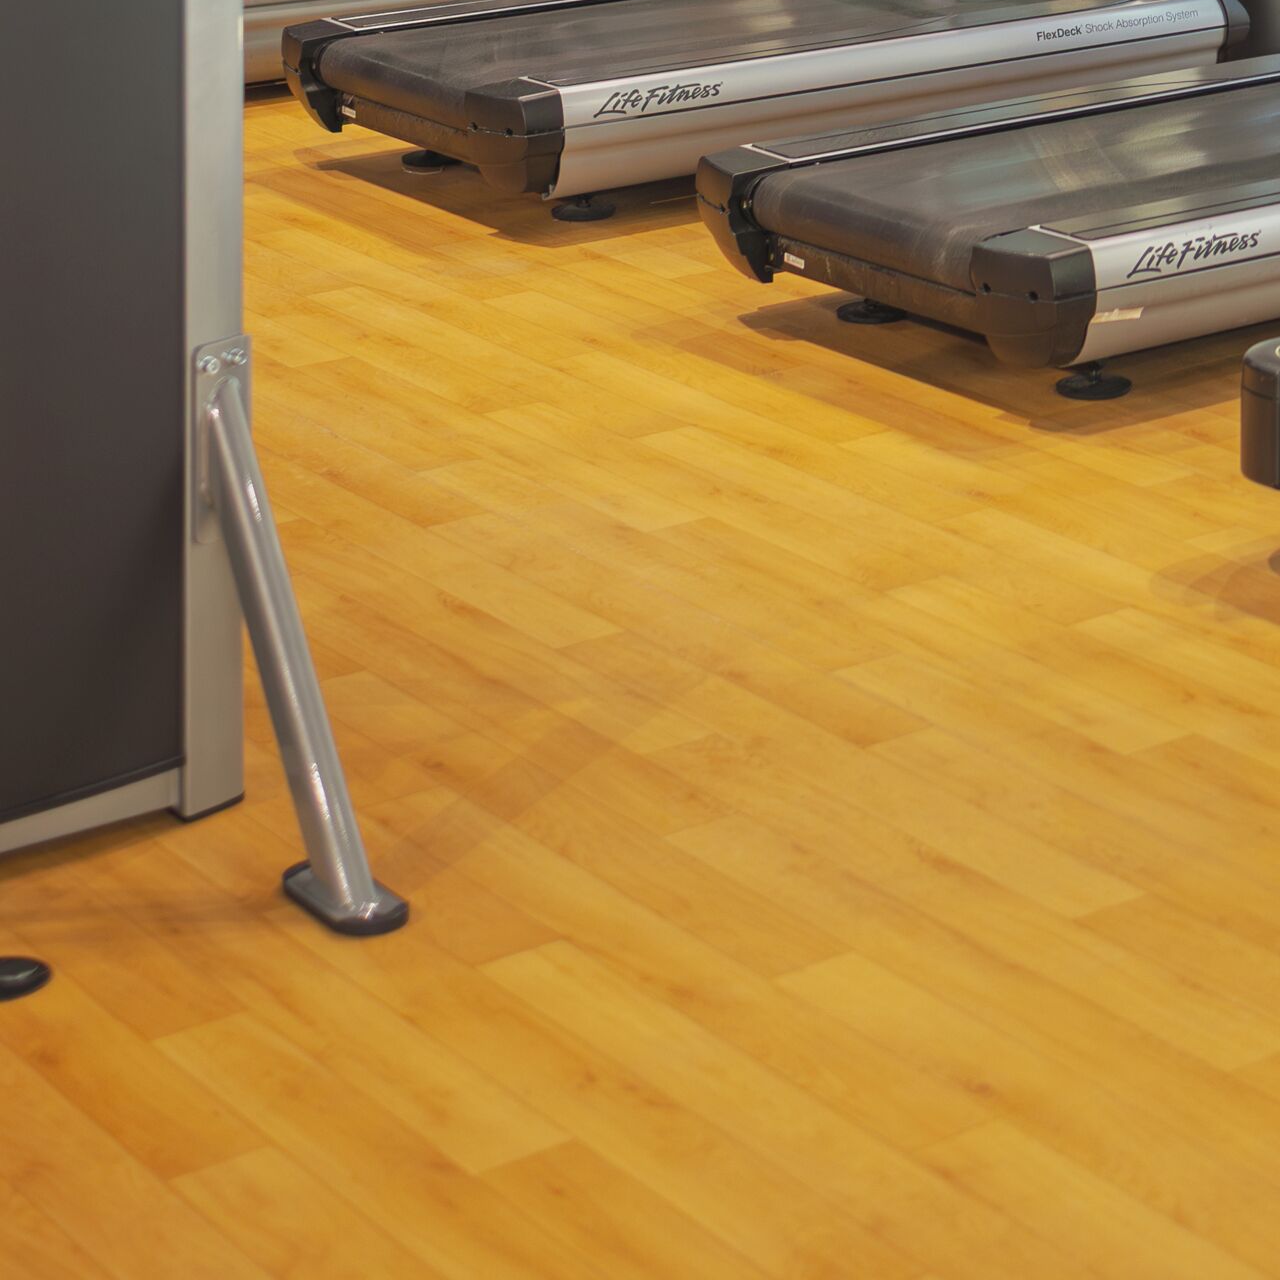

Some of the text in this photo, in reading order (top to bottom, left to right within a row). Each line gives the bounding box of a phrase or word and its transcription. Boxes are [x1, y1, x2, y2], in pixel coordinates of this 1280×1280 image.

[1036, 8, 1199, 41] FlexDeck Shock Absorption System
[593, 83, 722, 118] Life Fitness
[1126, 231, 1261, 279] Life Fitness
